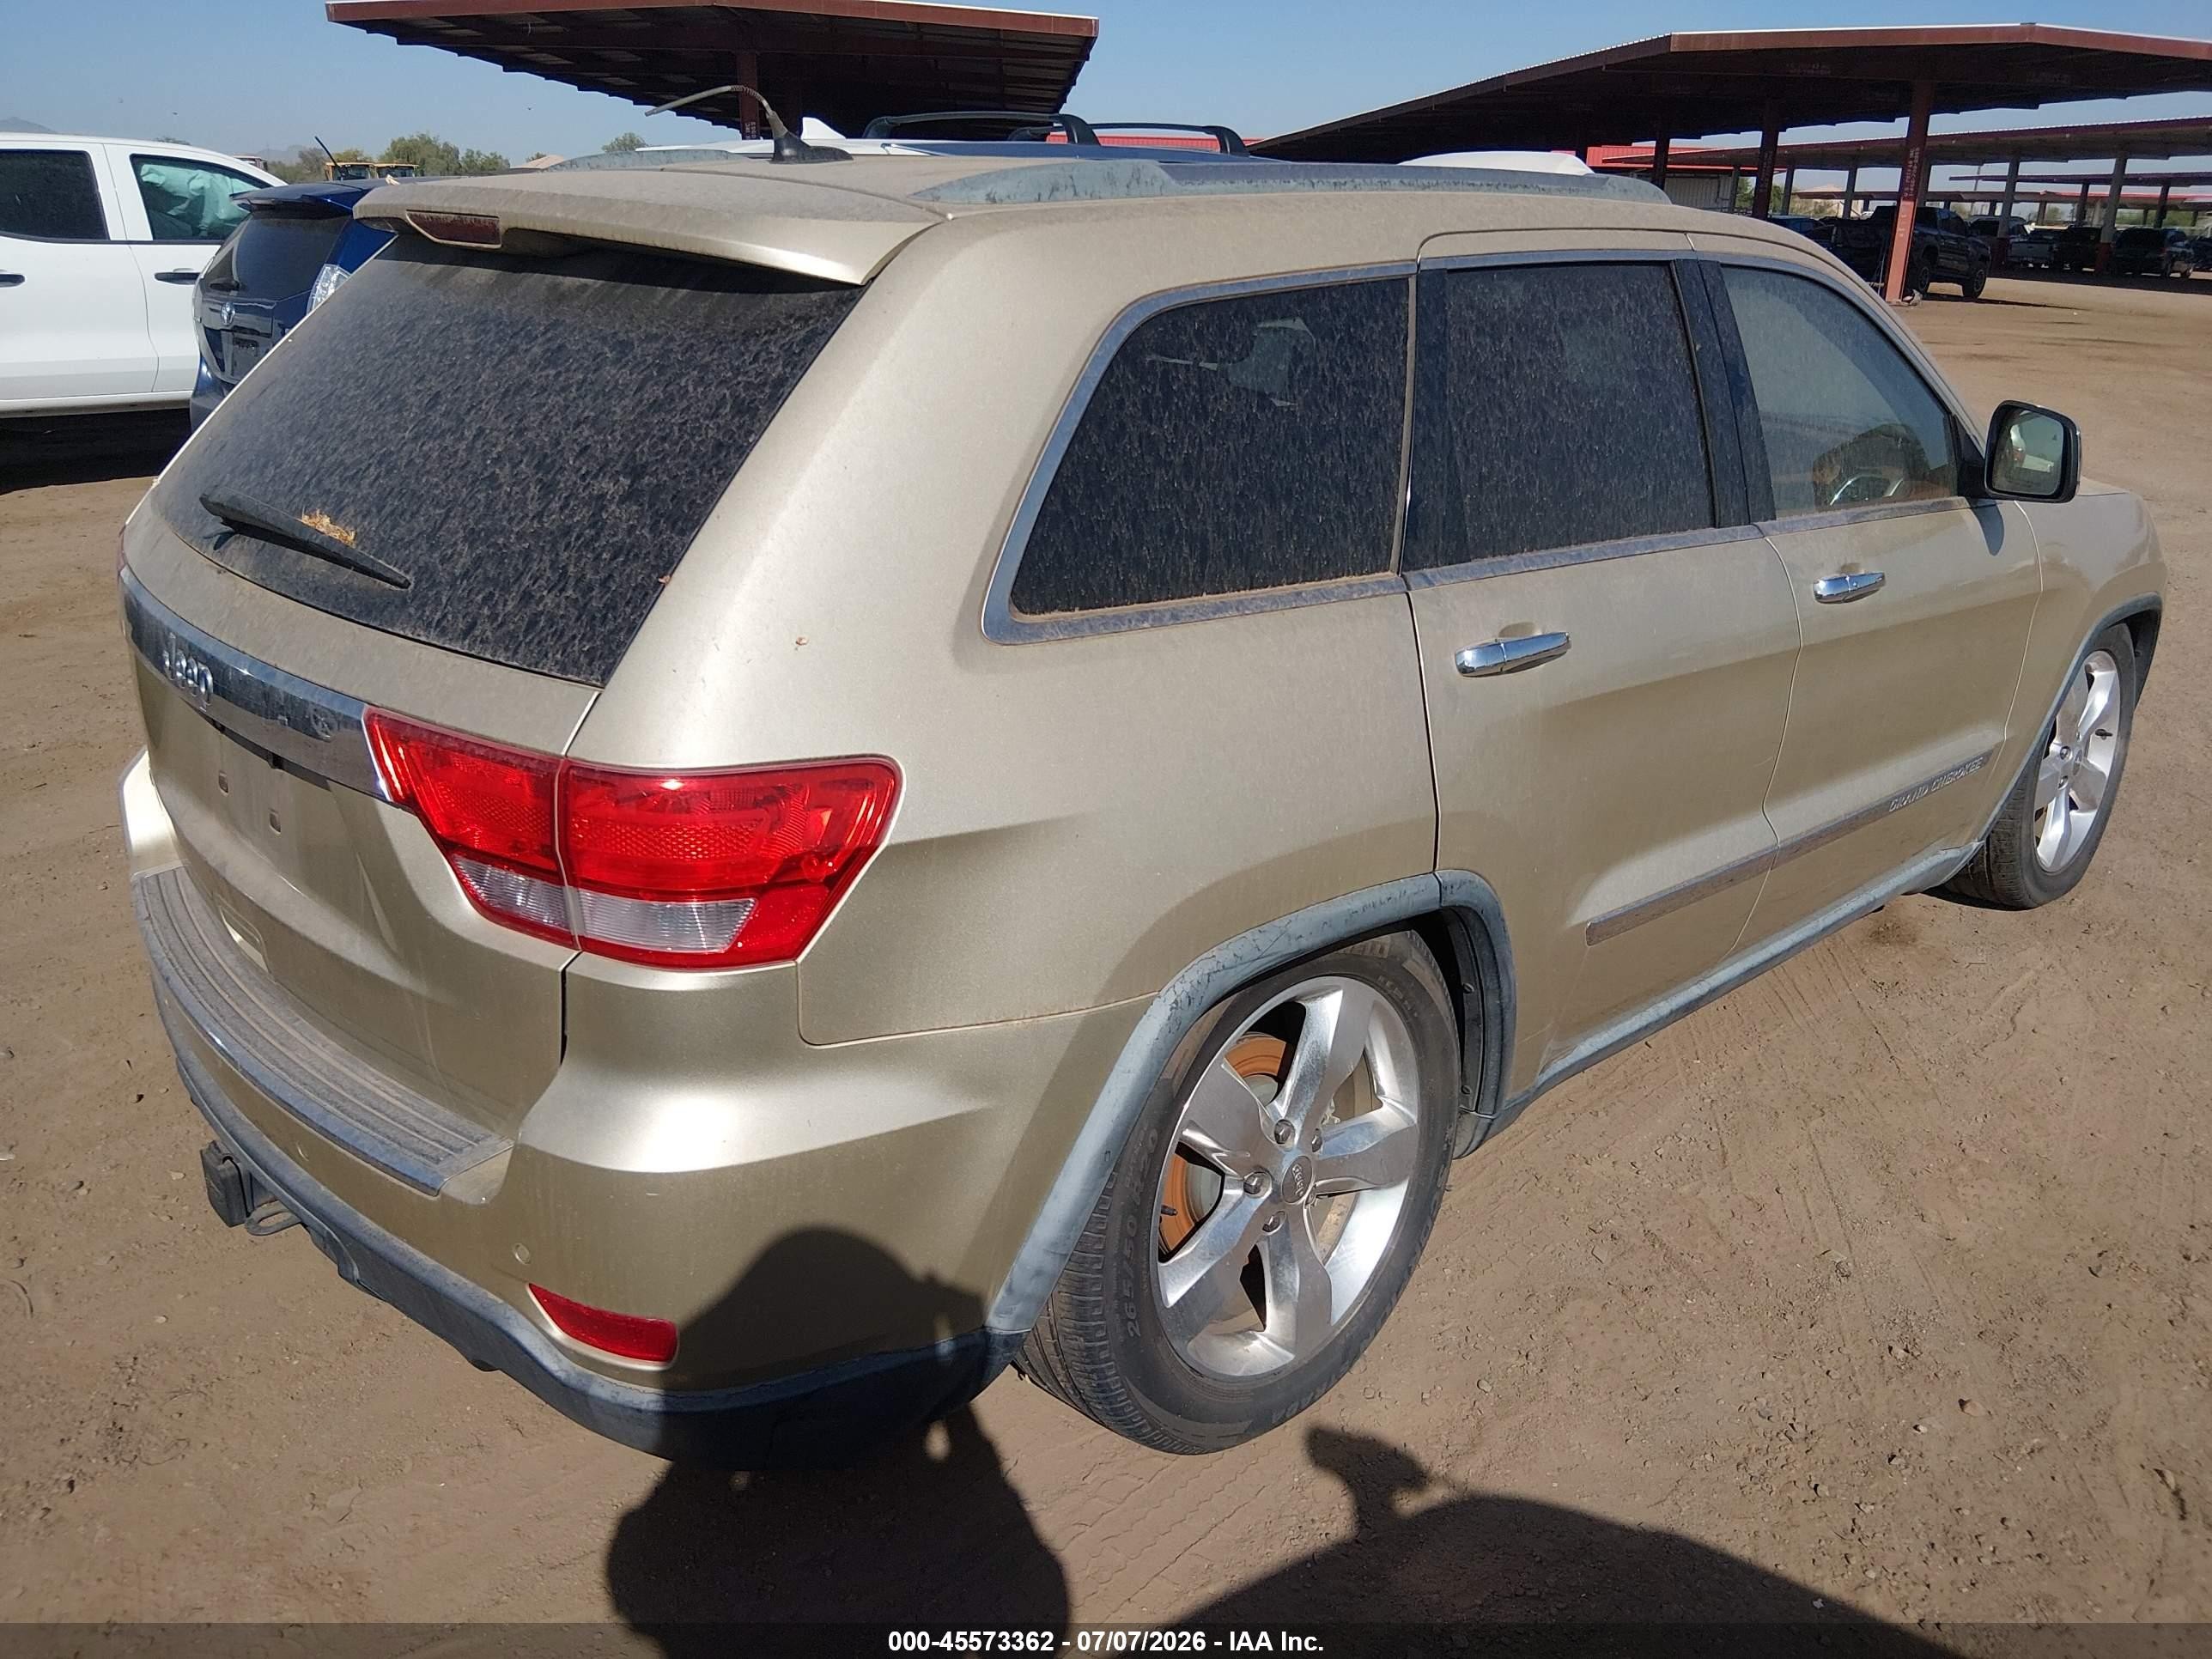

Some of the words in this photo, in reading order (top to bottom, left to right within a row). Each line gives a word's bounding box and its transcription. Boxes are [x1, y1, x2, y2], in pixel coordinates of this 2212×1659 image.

[162, 632, 214, 701] Jeep
[1889, 786, 1929, 812] GRAND
[1931, 757, 1984, 792] CHEROKEE
[1291, 1163, 1305, 1197] Jeep
